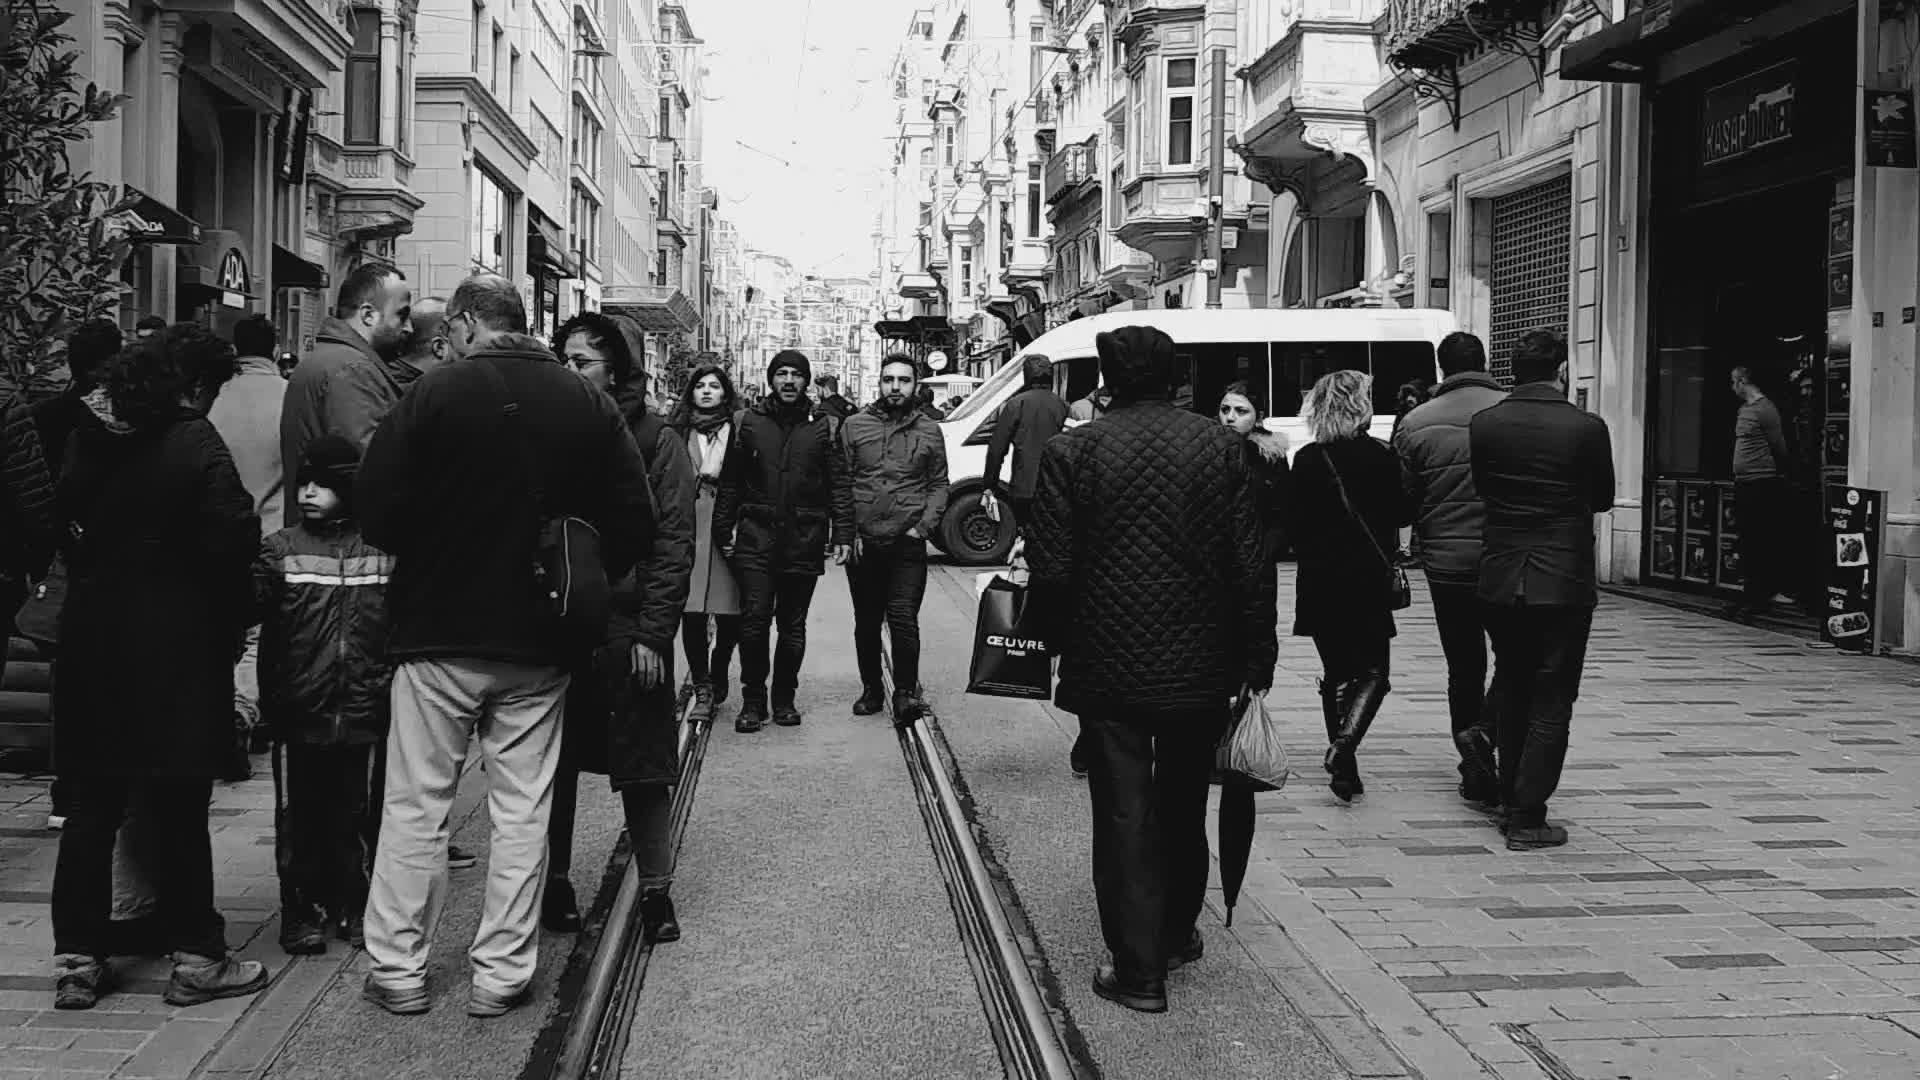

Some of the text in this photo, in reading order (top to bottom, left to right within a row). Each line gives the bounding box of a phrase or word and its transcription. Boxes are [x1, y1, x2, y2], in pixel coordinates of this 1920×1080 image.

[1704, 114, 1747, 160] KASAP
[224, 255, 245, 292] ADA
[986, 635, 1046, 651] ŒUVRE
